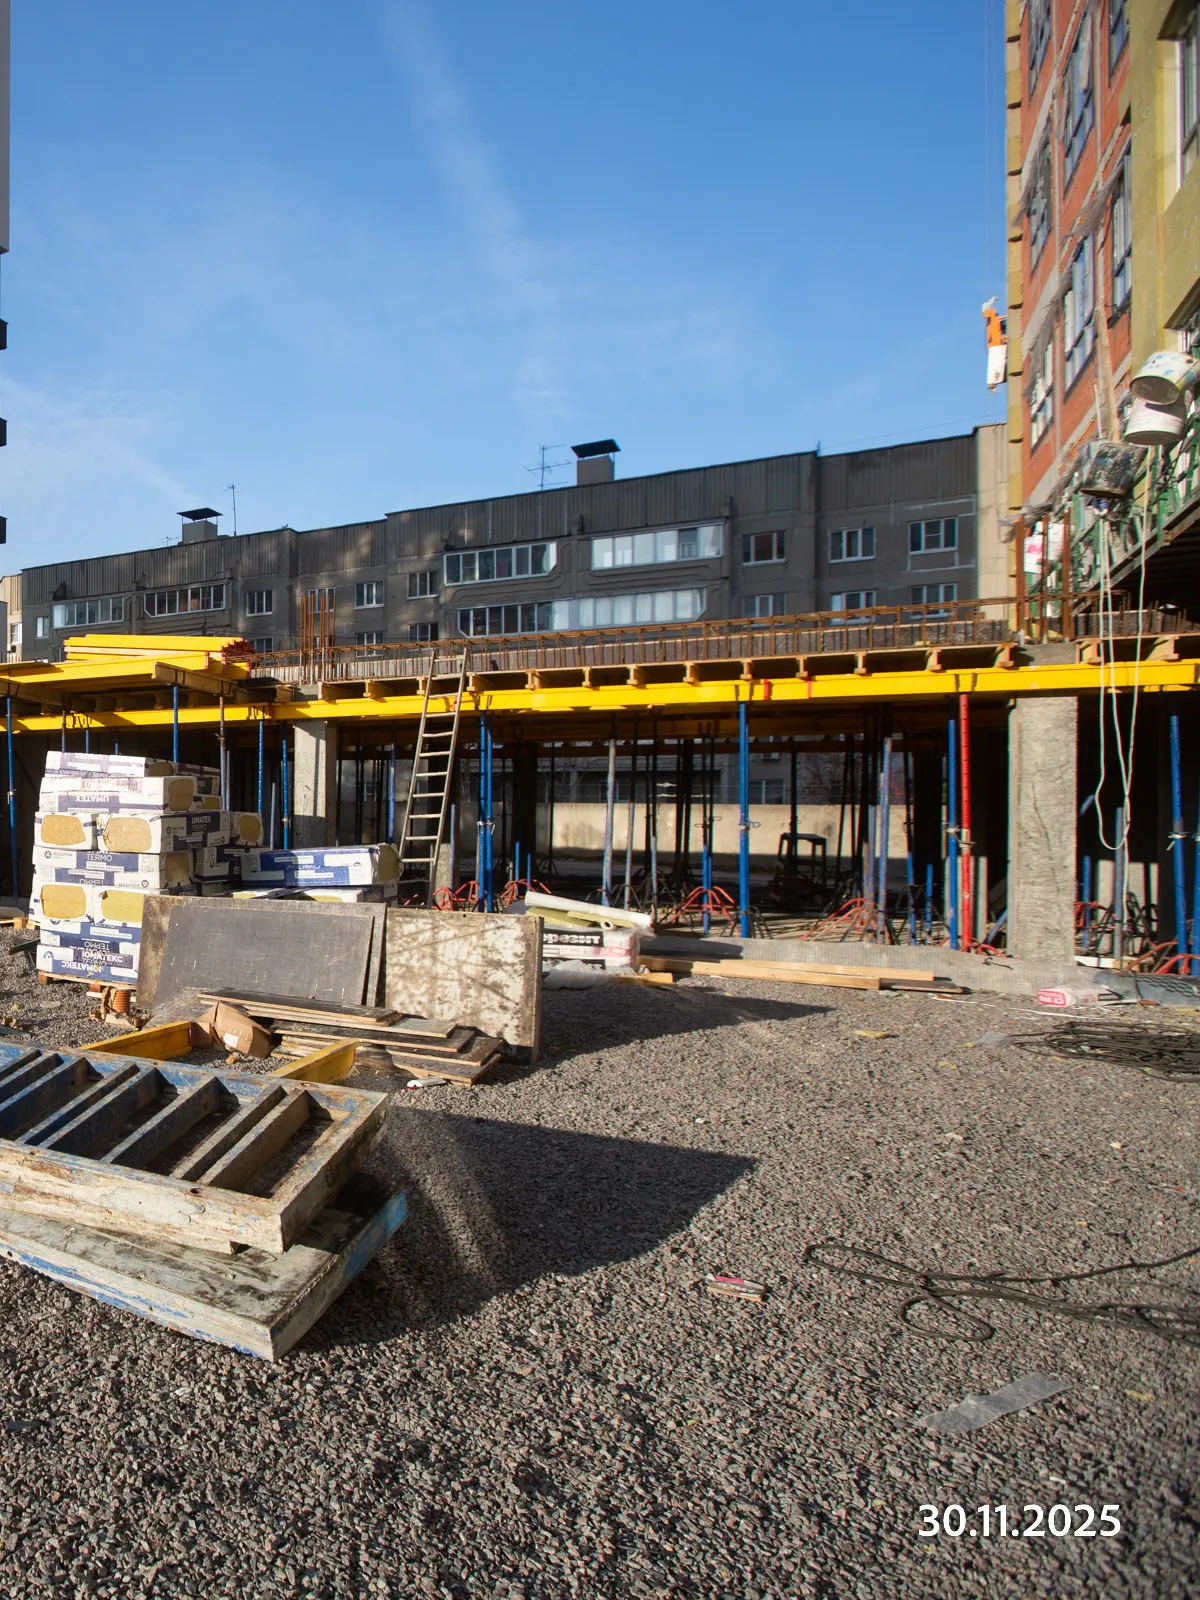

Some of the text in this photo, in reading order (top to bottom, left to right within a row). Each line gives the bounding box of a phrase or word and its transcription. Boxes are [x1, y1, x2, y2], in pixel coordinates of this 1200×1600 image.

[75, 795, 109, 803] UMATEX
[191, 816, 211, 824] UMATEX
[87, 854, 112, 862] TERMO
[82, 951, 123, 963] ЮМАТЕКС
